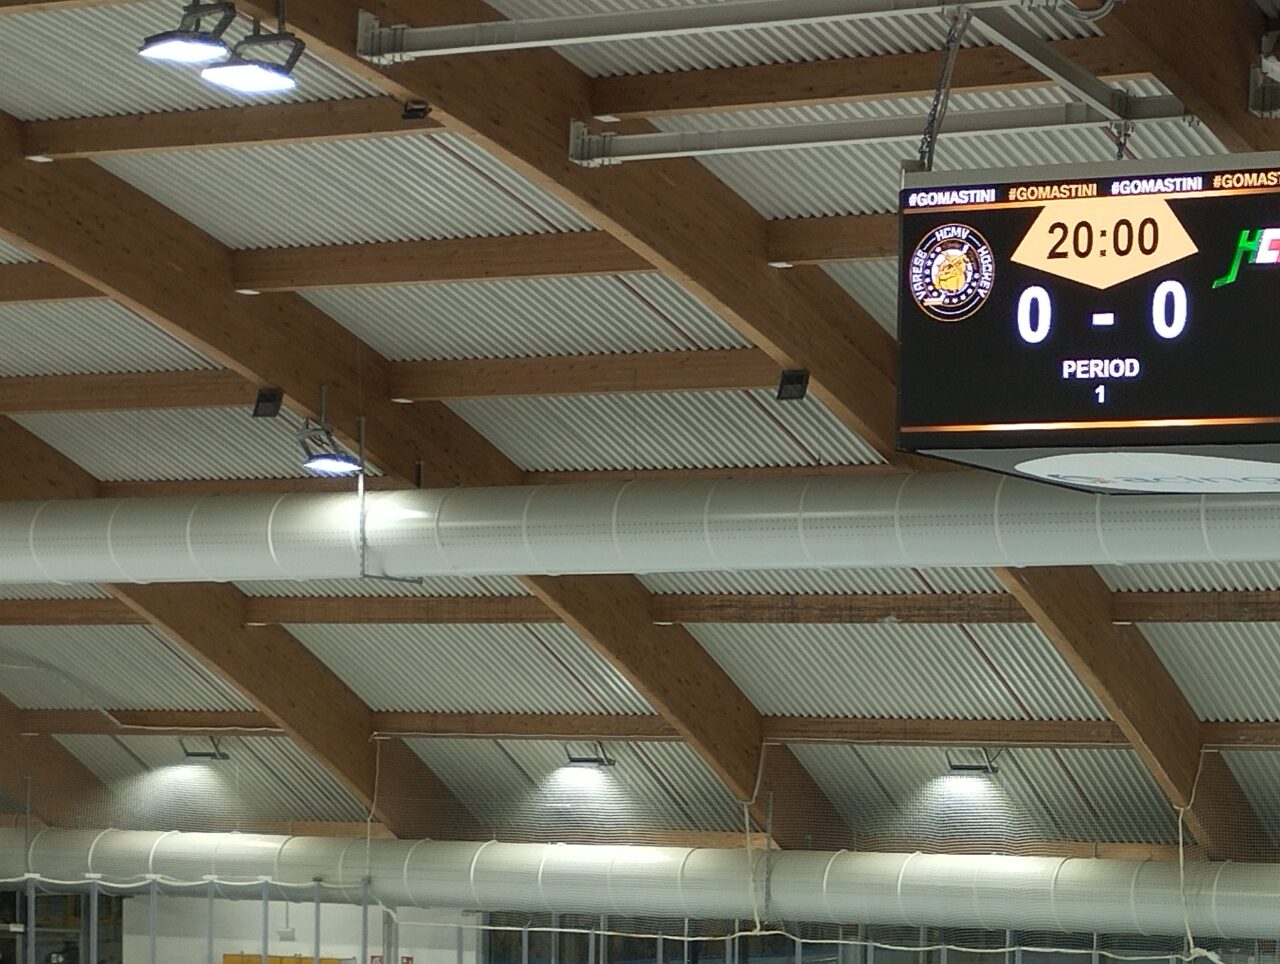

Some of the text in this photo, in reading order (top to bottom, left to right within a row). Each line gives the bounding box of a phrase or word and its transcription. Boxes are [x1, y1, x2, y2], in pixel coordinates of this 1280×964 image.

[909, 188, 995, 207] #GOMASTINI
[1008, 183, 1097, 201] #GOMASTINI
[1111, 176, 1202, 195] #GOMASTINI
[1047, 217, 1159, 260] 20:00
[977, 245, 993, 298] HOCKEY
[1017, 285, 1051, 344] 0
[1152, 280, 1187, 339] 0
[1063, 358, 1140, 379] PERIOD
[1095, 385, 1105, 403] 1
